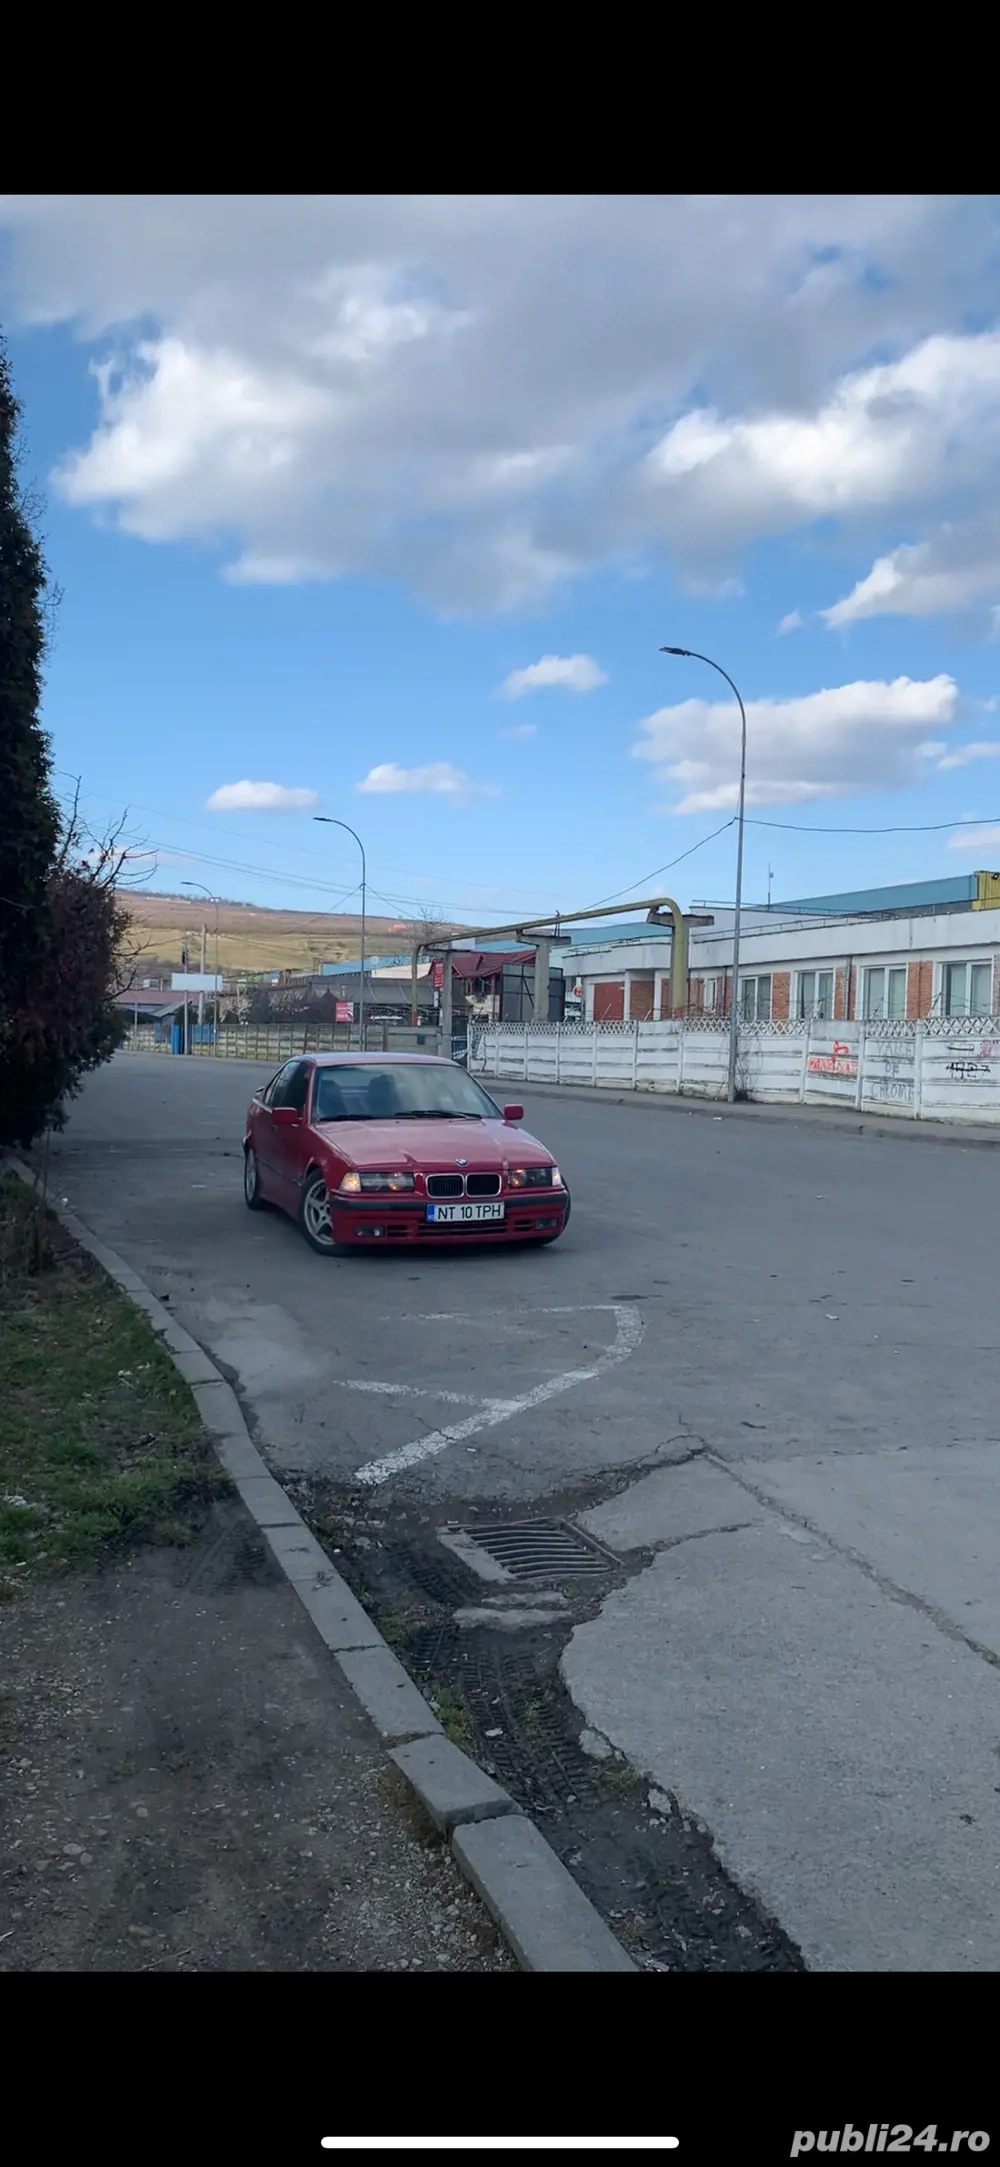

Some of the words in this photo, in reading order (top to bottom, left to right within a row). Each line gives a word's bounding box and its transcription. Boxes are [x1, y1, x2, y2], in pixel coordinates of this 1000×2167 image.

[438, 1207, 456, 1220] NT
[460, 1206, 473, 1219] 10
[476, 1204, 501, 1218] TPH
